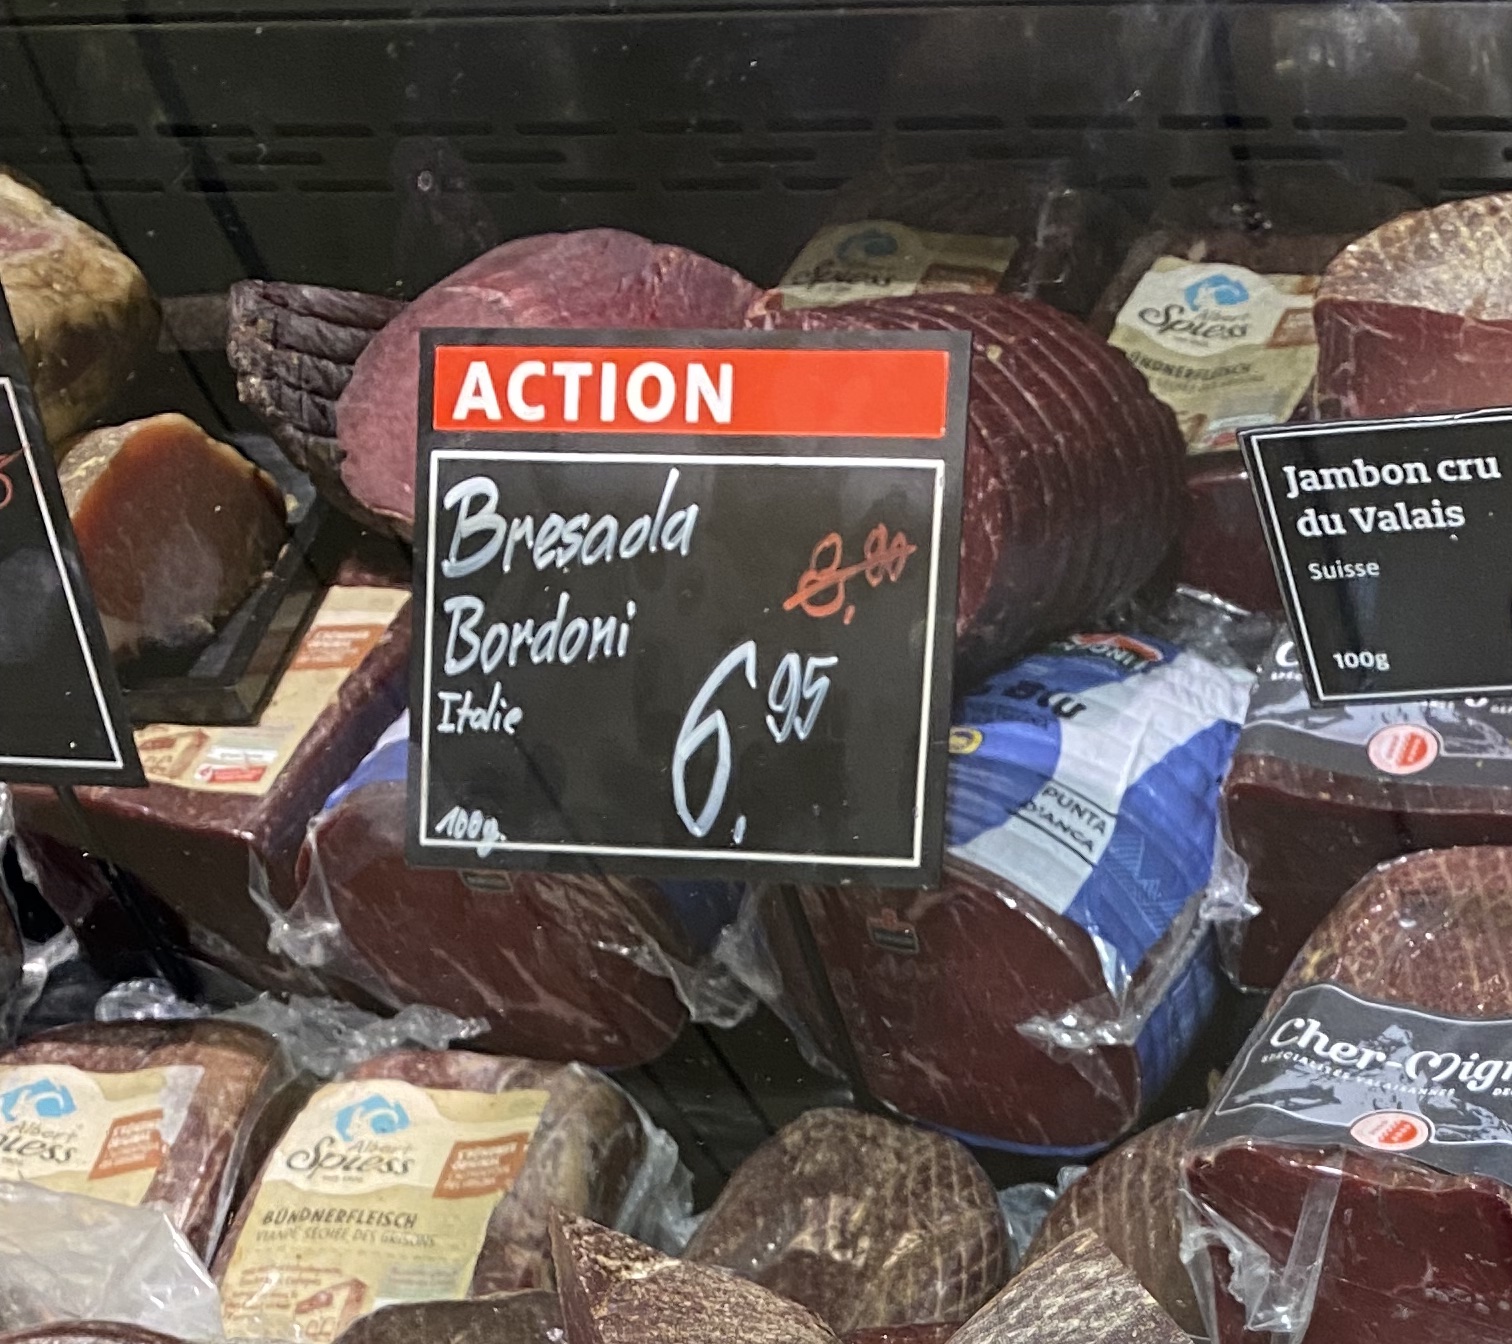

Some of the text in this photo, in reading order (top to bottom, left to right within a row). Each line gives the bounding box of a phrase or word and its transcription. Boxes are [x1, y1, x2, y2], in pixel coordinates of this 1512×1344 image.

[451, 360, 735, 425] ACTION
[1283, 454, 1502, 499] Jambon cru
[441, 467, 699, 578] Bresaola
[1296, 498, 1466, 538] du Valais
[1307, 559, 1380, 582] Suisse
[443, 592, 637, 676] Bordoni
[1332, 651, 1391, 673] 100g
[436, 682, 524, 736] Italie
[1041, 786, 1108, 835] PUNTA
[286, 1136, 415, 1180] Spiess
